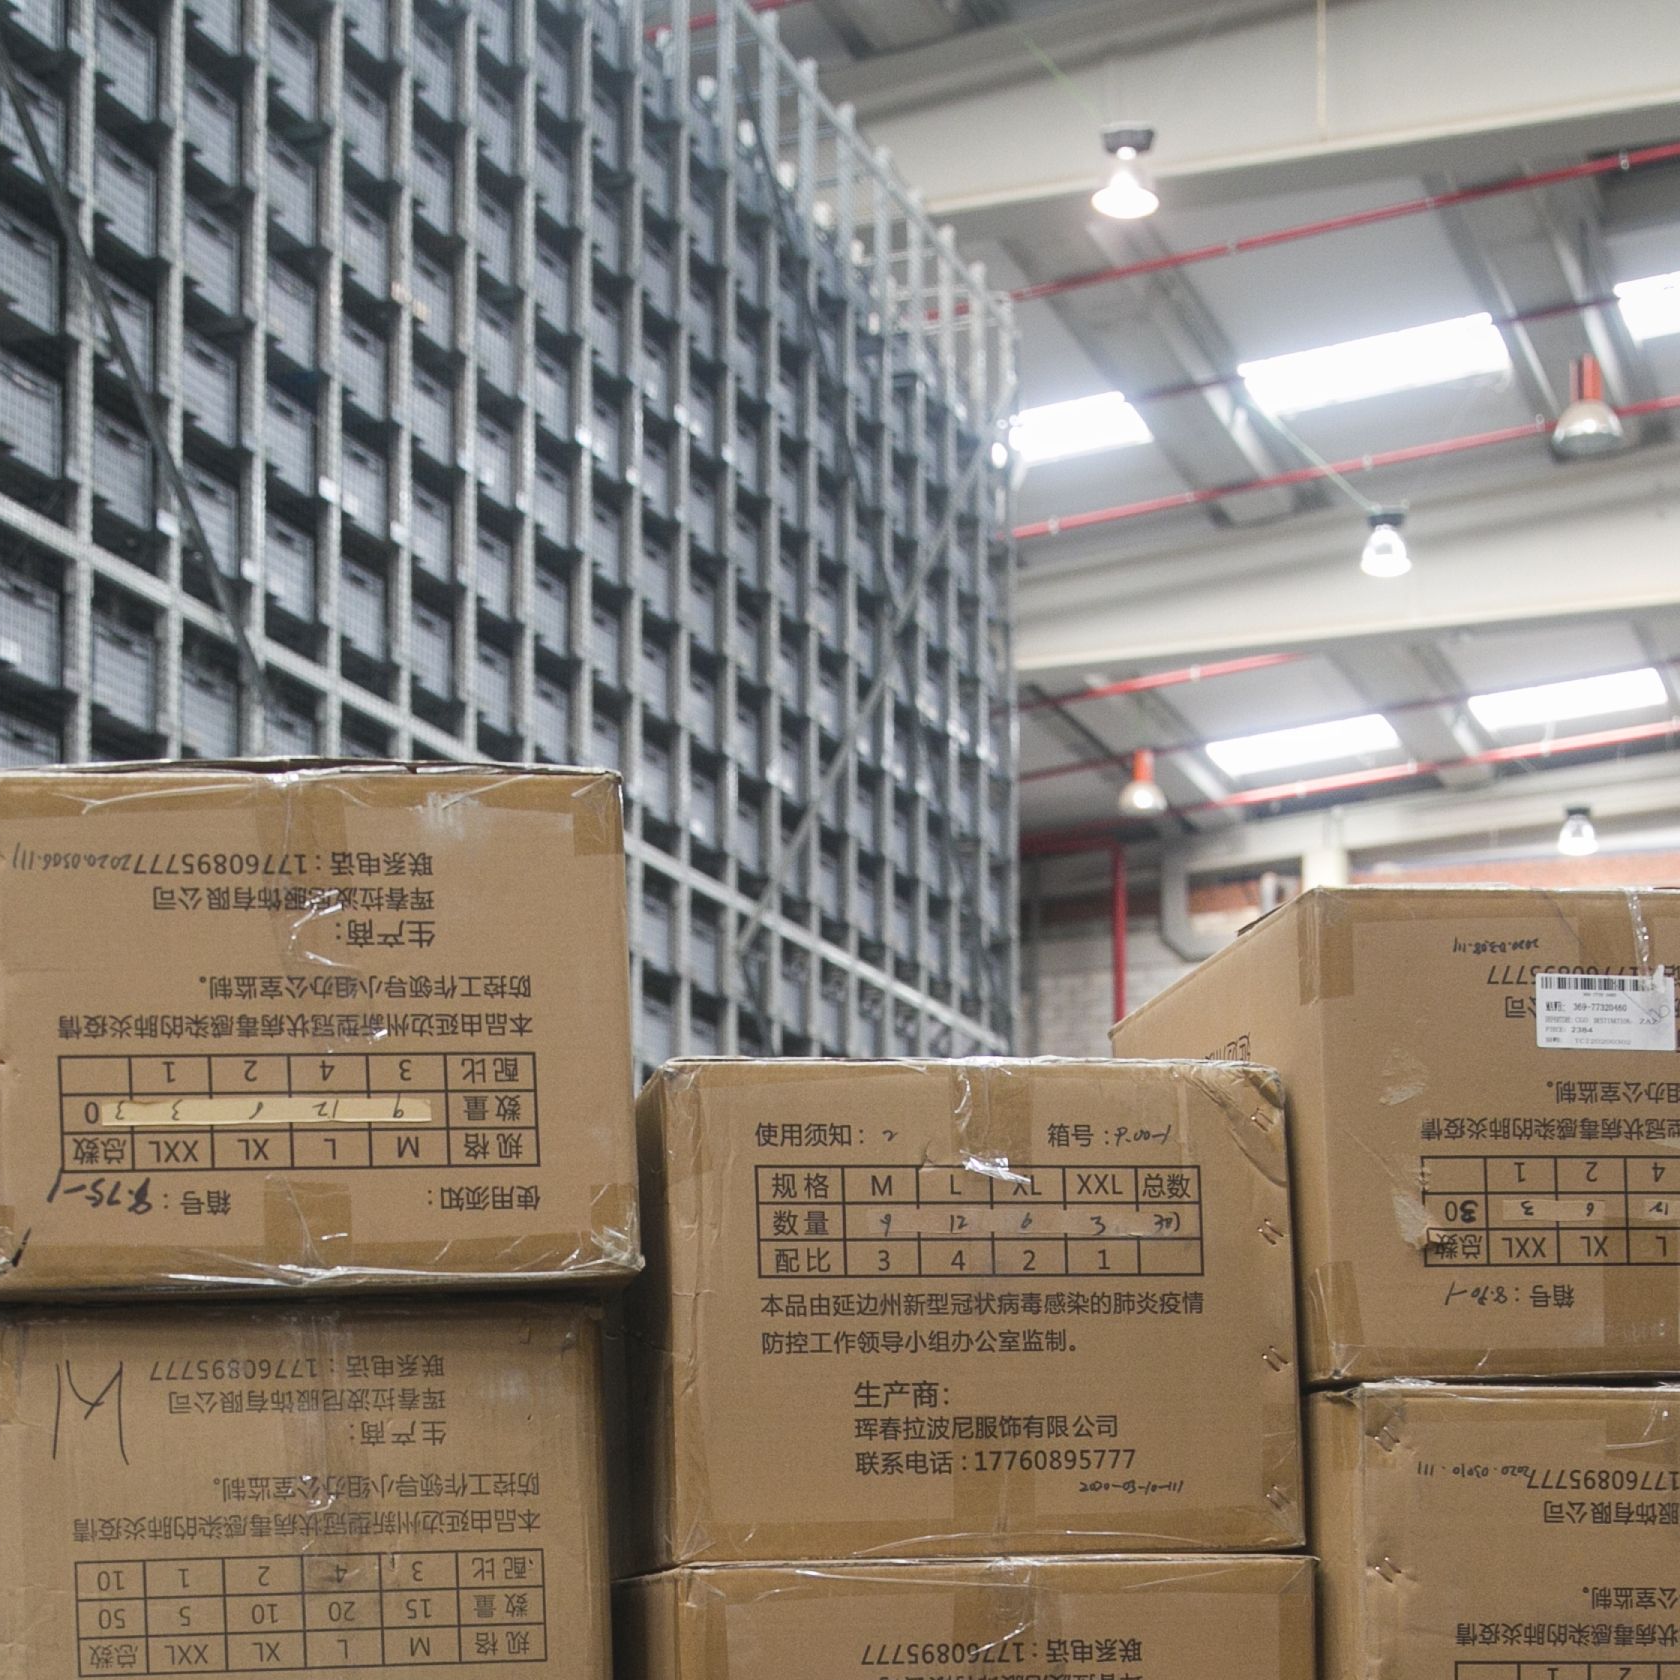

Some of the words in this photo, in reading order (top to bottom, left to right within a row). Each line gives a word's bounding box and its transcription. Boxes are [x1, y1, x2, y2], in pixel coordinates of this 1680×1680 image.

[97, 1569, 124, 1589] 10
[179, 1564, 191, 1585] 1
[260, 1561, 274, 1583] 2
[411, 1557, 425, 1580] 3
[99, 1607, 125, 1628] 50
[179, 1605, 191, 1626] 5
[252, 1603, 278, 1623] 10
[329, 1601, 355, 1621] 20
[405, 1598, 433, 1619] 15
[163, 1641, 215, 1665] XXL
[252, 1639, 284, 1662] XL
[338, 1637, 351, 1659] L
[409, 1634, 430, 1656] M
